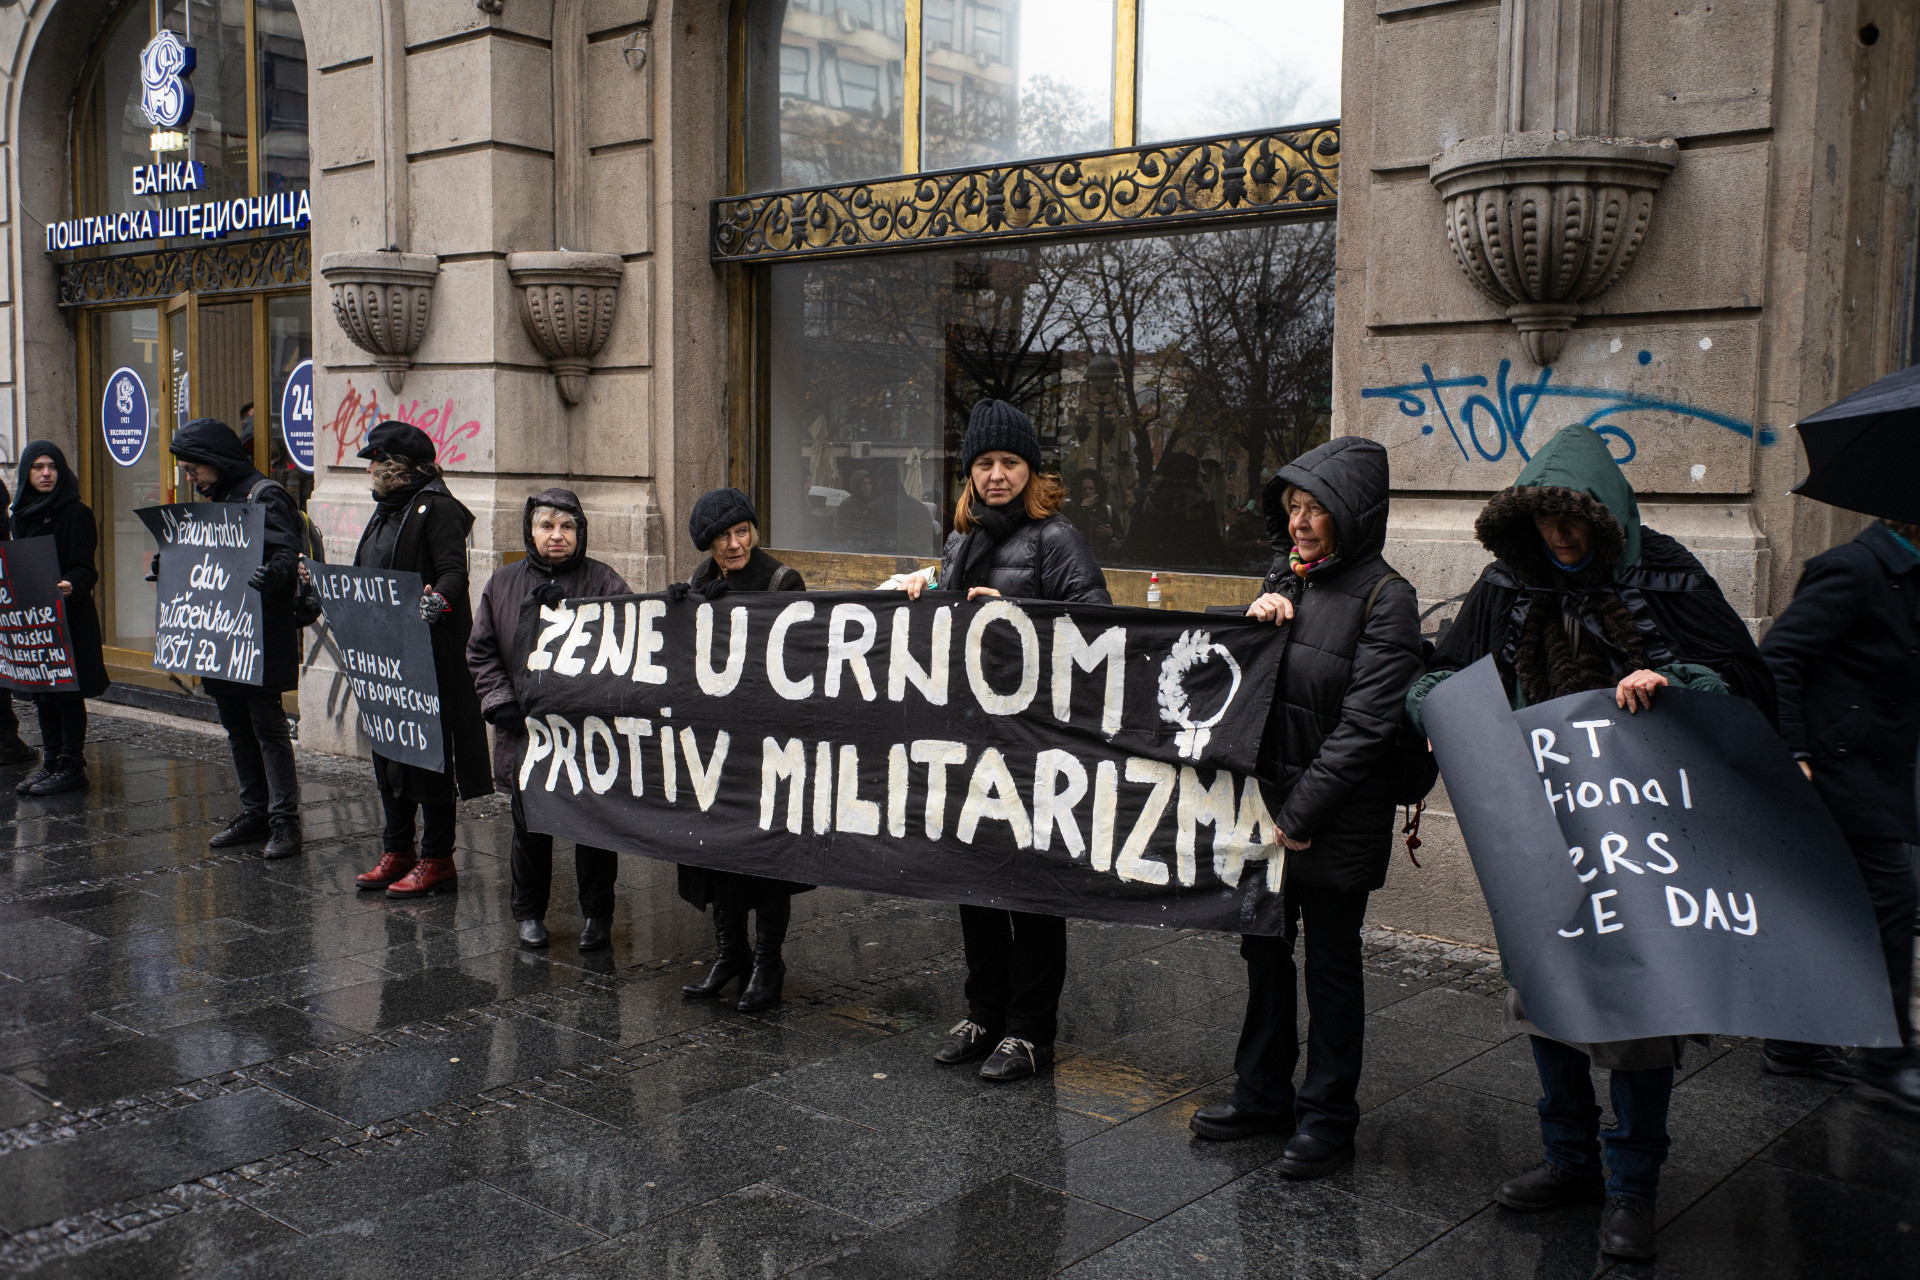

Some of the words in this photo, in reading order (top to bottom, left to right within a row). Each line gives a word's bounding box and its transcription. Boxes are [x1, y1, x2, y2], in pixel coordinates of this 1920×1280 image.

[132, 160, 198, 196] БАНКА
[46, 209, 154, 250] ПОШТАНСКА
[158, 189, 312, 240] ШТЕДИОНИЦА
[292, 384, 313, 421] 24
[109, 429, 142, 437] ЕКСПОЗИТУРА
[112, 437, 127, 445] Branch
[127, 437, 140, 446] Office
[189, 552, 231, 591] dan
[11, 628, 54, 646] vojsku
[194, 638, 221, 673] za
[526, 599, 669, 685] ŽENE
[695, 602, 749, 698] U
[766, 599, 1127, 738] CRNOM
[349, 676, 440, 716] ОТВОРЧЕСКУЮ
[759, 735, 1286, 893] MILITARIZMA
[1557, 888, 1625, 938] E
